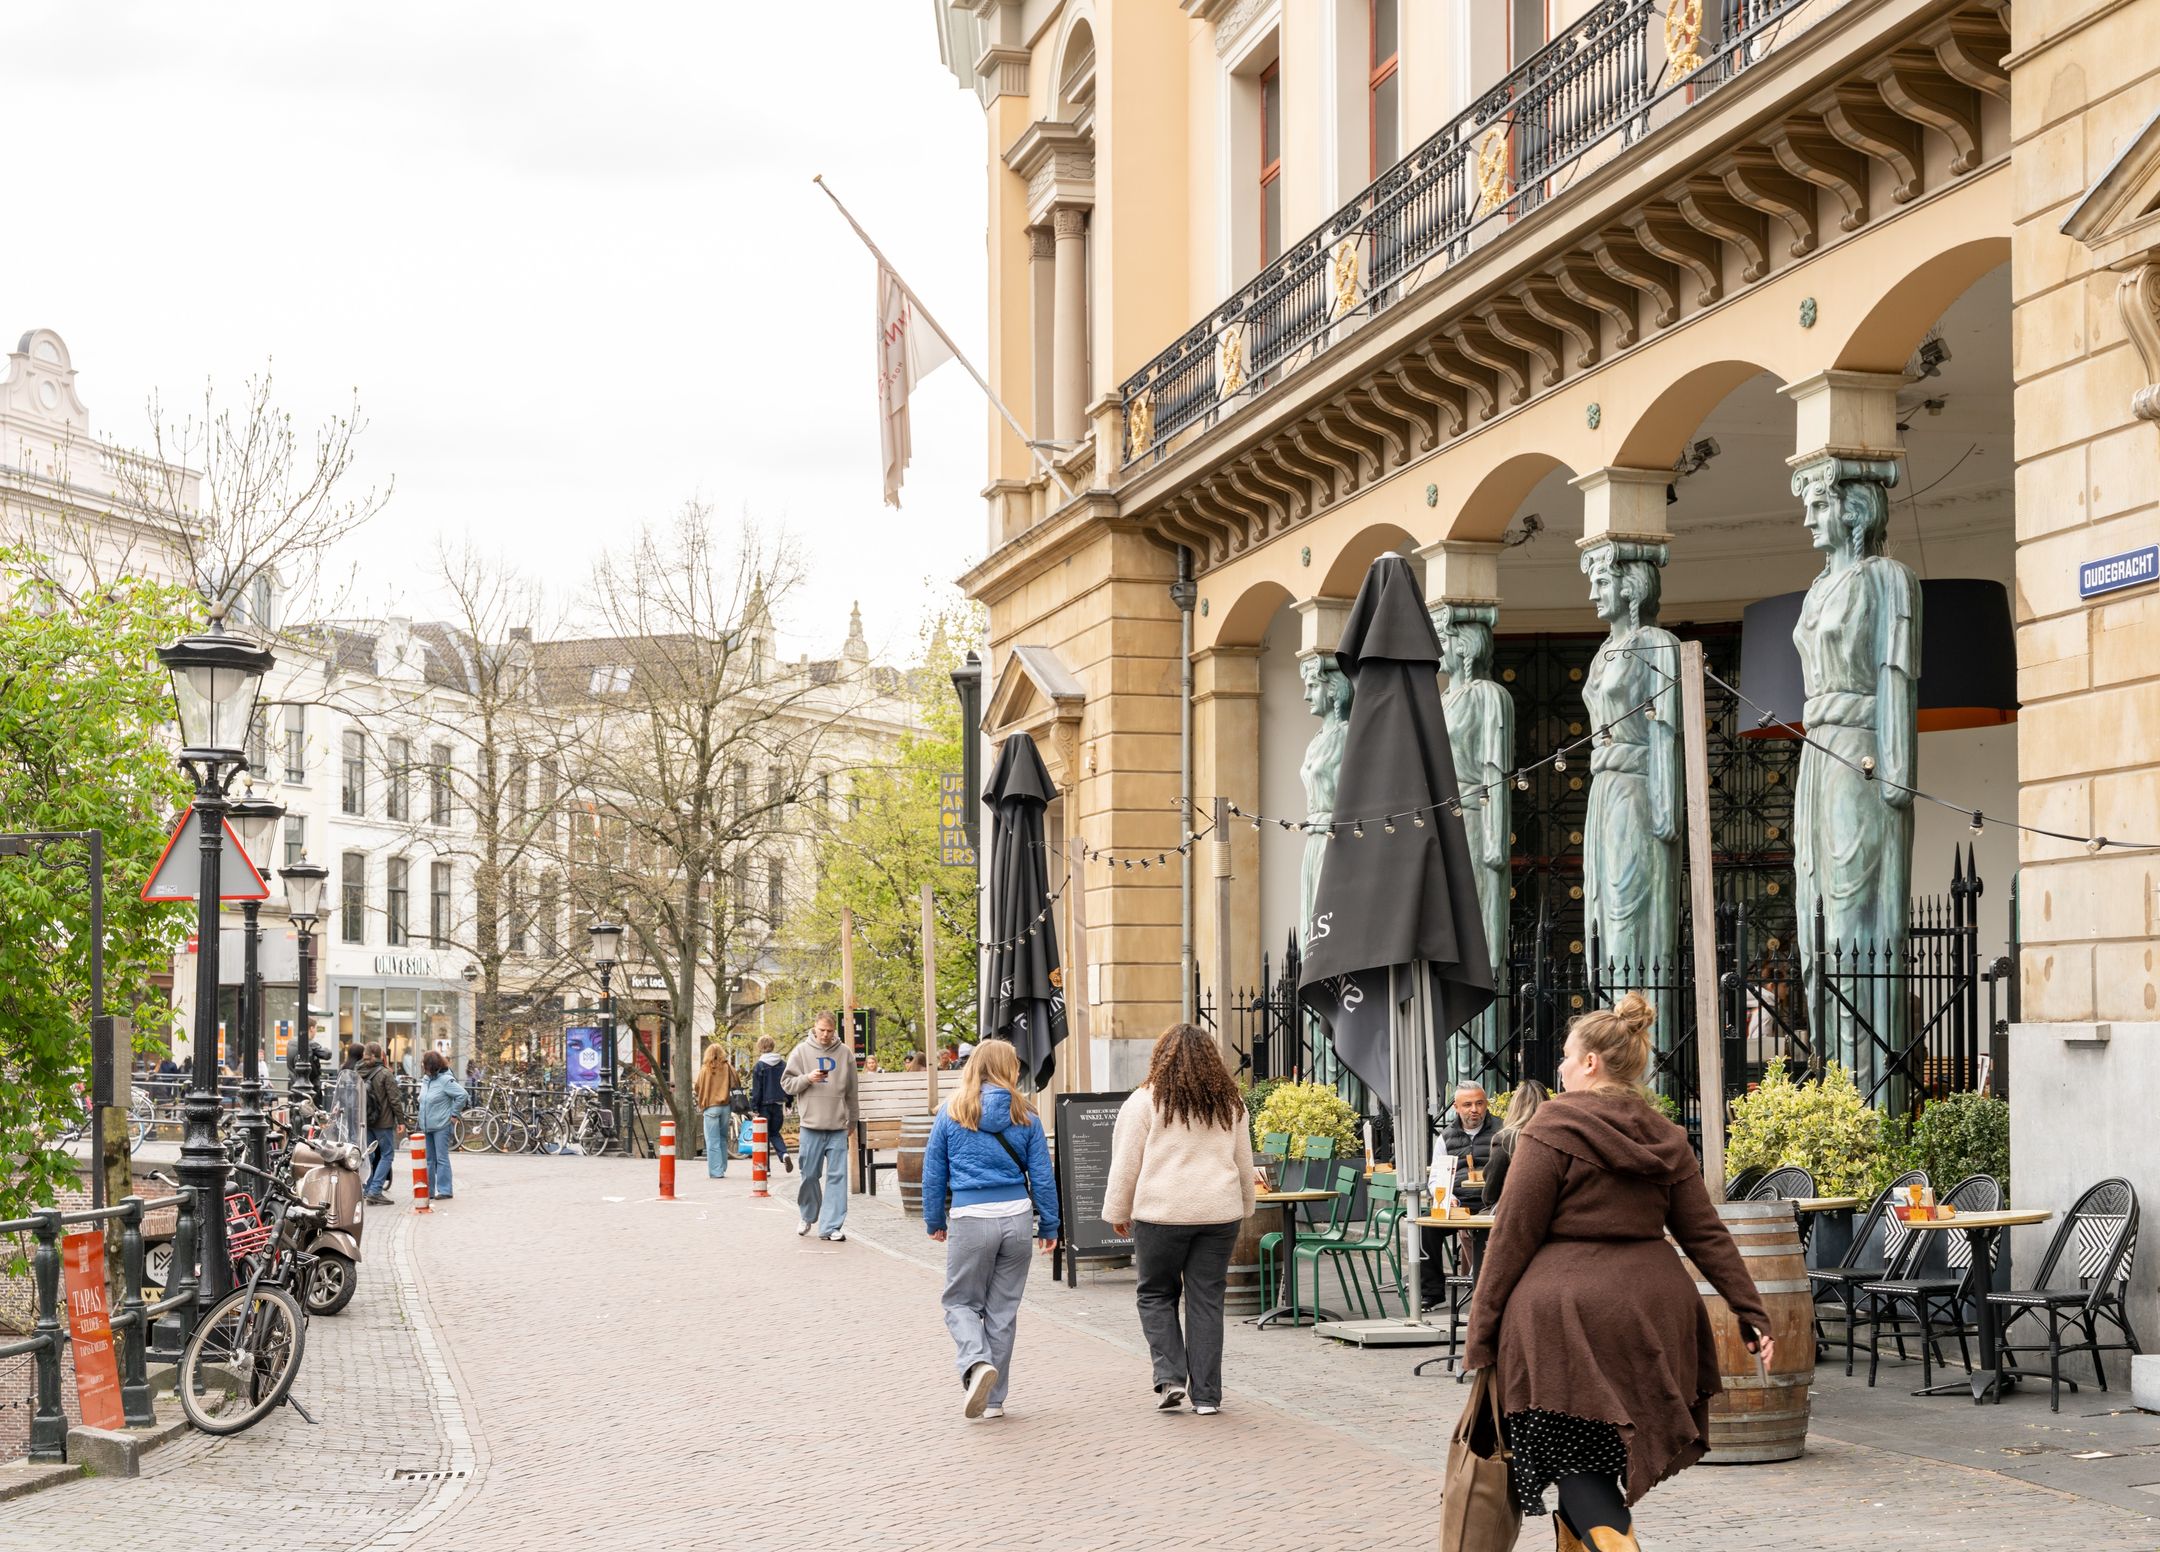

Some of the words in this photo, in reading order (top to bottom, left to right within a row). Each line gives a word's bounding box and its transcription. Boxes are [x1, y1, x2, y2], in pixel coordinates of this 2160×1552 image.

[2084, 553, 2154, 589] OUDEGRACHT
[942, 777, 964, 793] UR
[943, 812, 963, 829] OU
[943, 848, 975, 865] ERS
[72, 1286, 102, 1317] TAPAS
